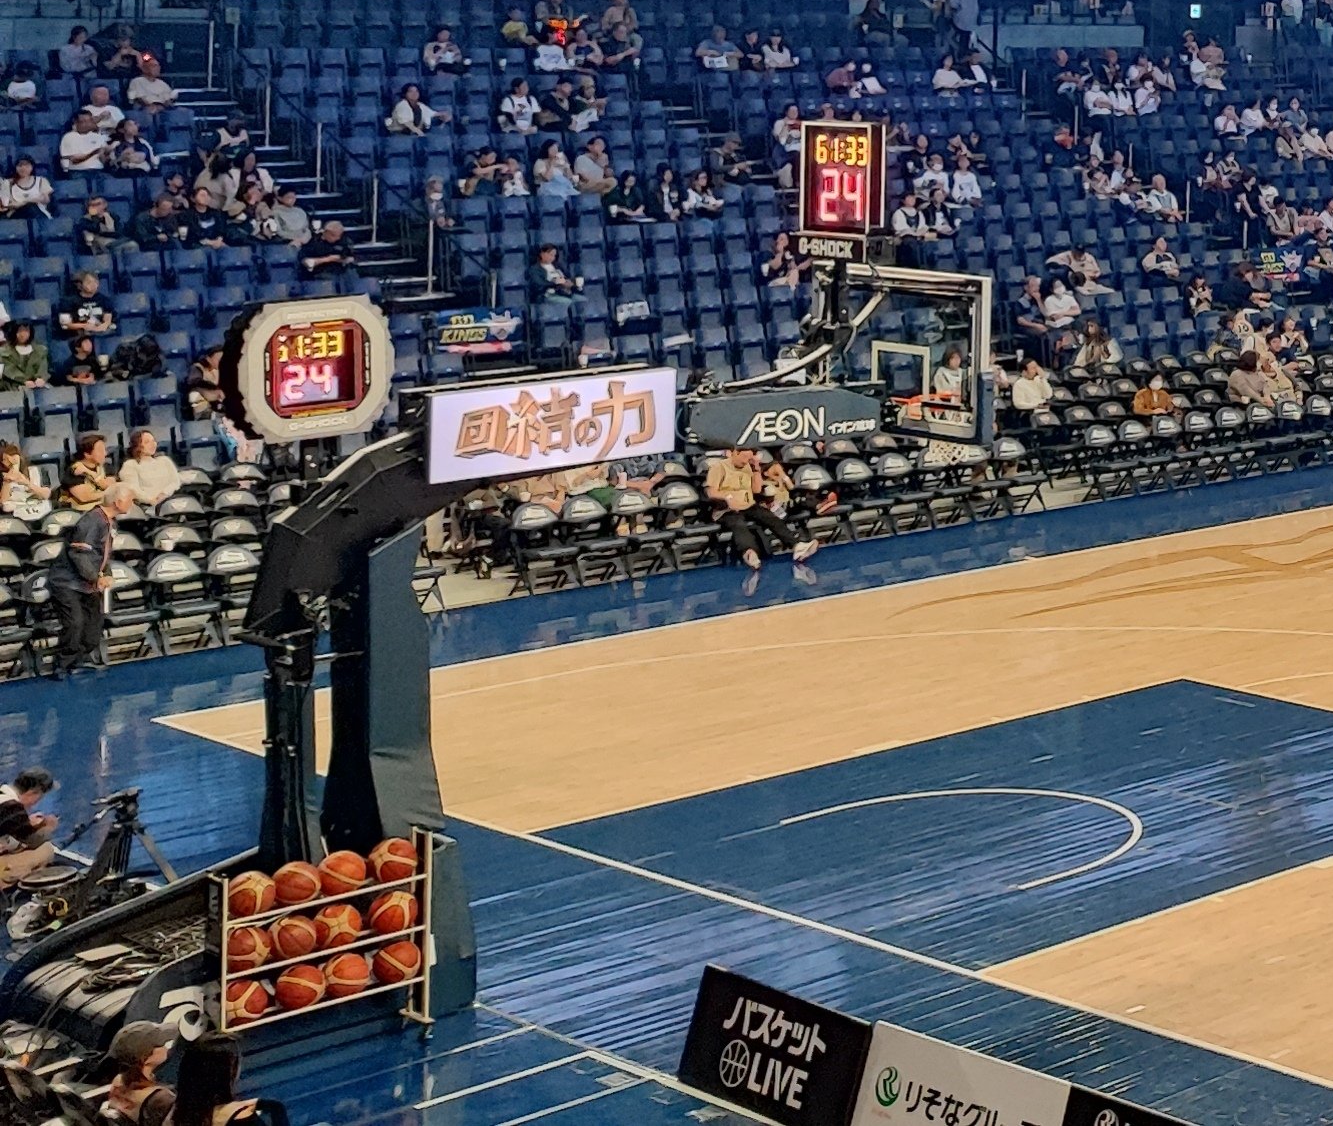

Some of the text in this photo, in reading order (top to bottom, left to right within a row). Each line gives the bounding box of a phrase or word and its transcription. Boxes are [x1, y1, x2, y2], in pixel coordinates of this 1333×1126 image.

[815, 134, 868, 166] 61:33
[820, 168, 864, 223] 24
[797, 237, 853, 259] G-SHOCK
[282, 365, 333, 400] 24
[289, 413, 350, 432] G-SHOCK
[454, 380, 657, 462] 団結の力
[722, 996, 827, 1062] バスケット
[746, 1051, 810, 1111] LIVE
[905, 1081, 1041, 1126] りそなグル
